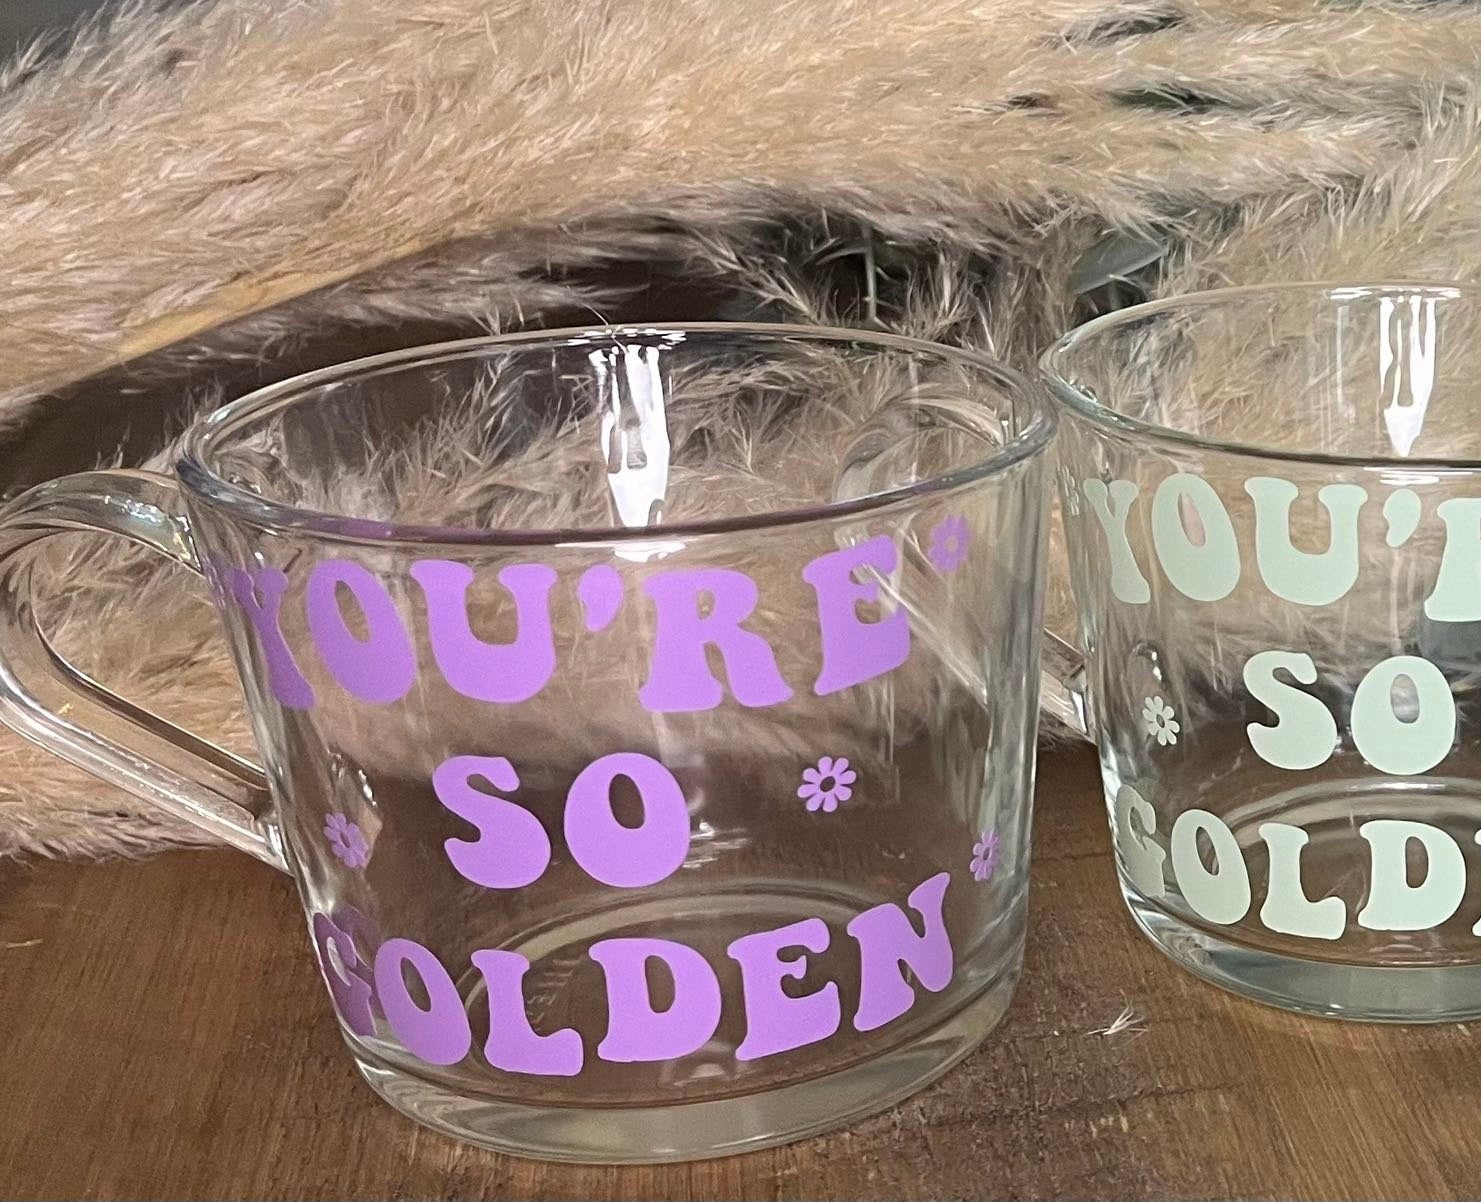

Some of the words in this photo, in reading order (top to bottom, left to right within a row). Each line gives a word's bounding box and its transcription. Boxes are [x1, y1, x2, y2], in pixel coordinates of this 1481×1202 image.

[230, 534, 913, 712] YOU'RE
[1242, 650, 1457, 775] SO
[432, 752, 692, 888] SO
[312, 872, 955, 1077] GOLDEN
